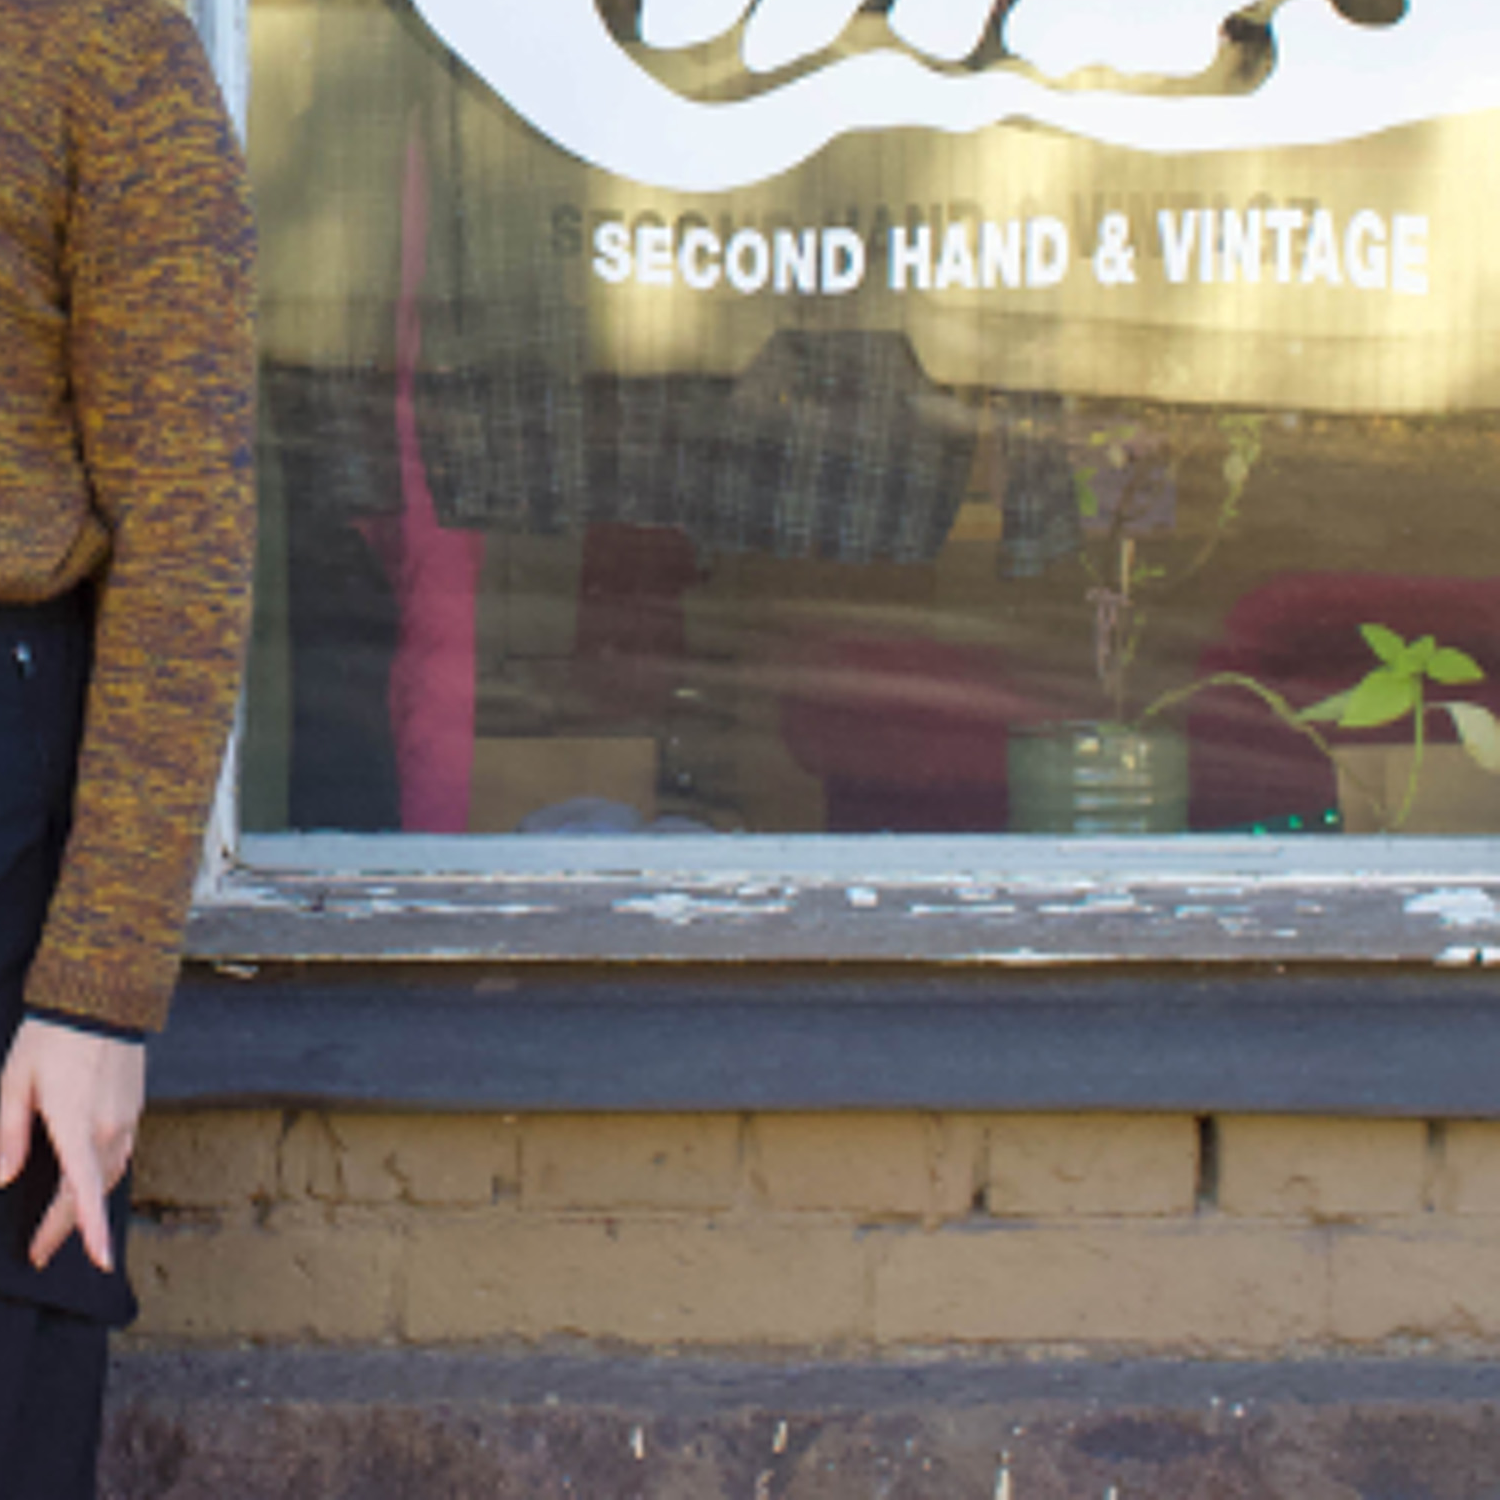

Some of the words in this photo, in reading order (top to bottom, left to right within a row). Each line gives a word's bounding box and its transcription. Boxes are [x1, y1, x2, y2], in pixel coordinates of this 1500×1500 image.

[592, 222, 866, 294] SECOND
[888, 214, 1071, 291] HAND
[1091, 211, 1137, 287] &
[1156, 205, 1433, 299] VINTAGE
